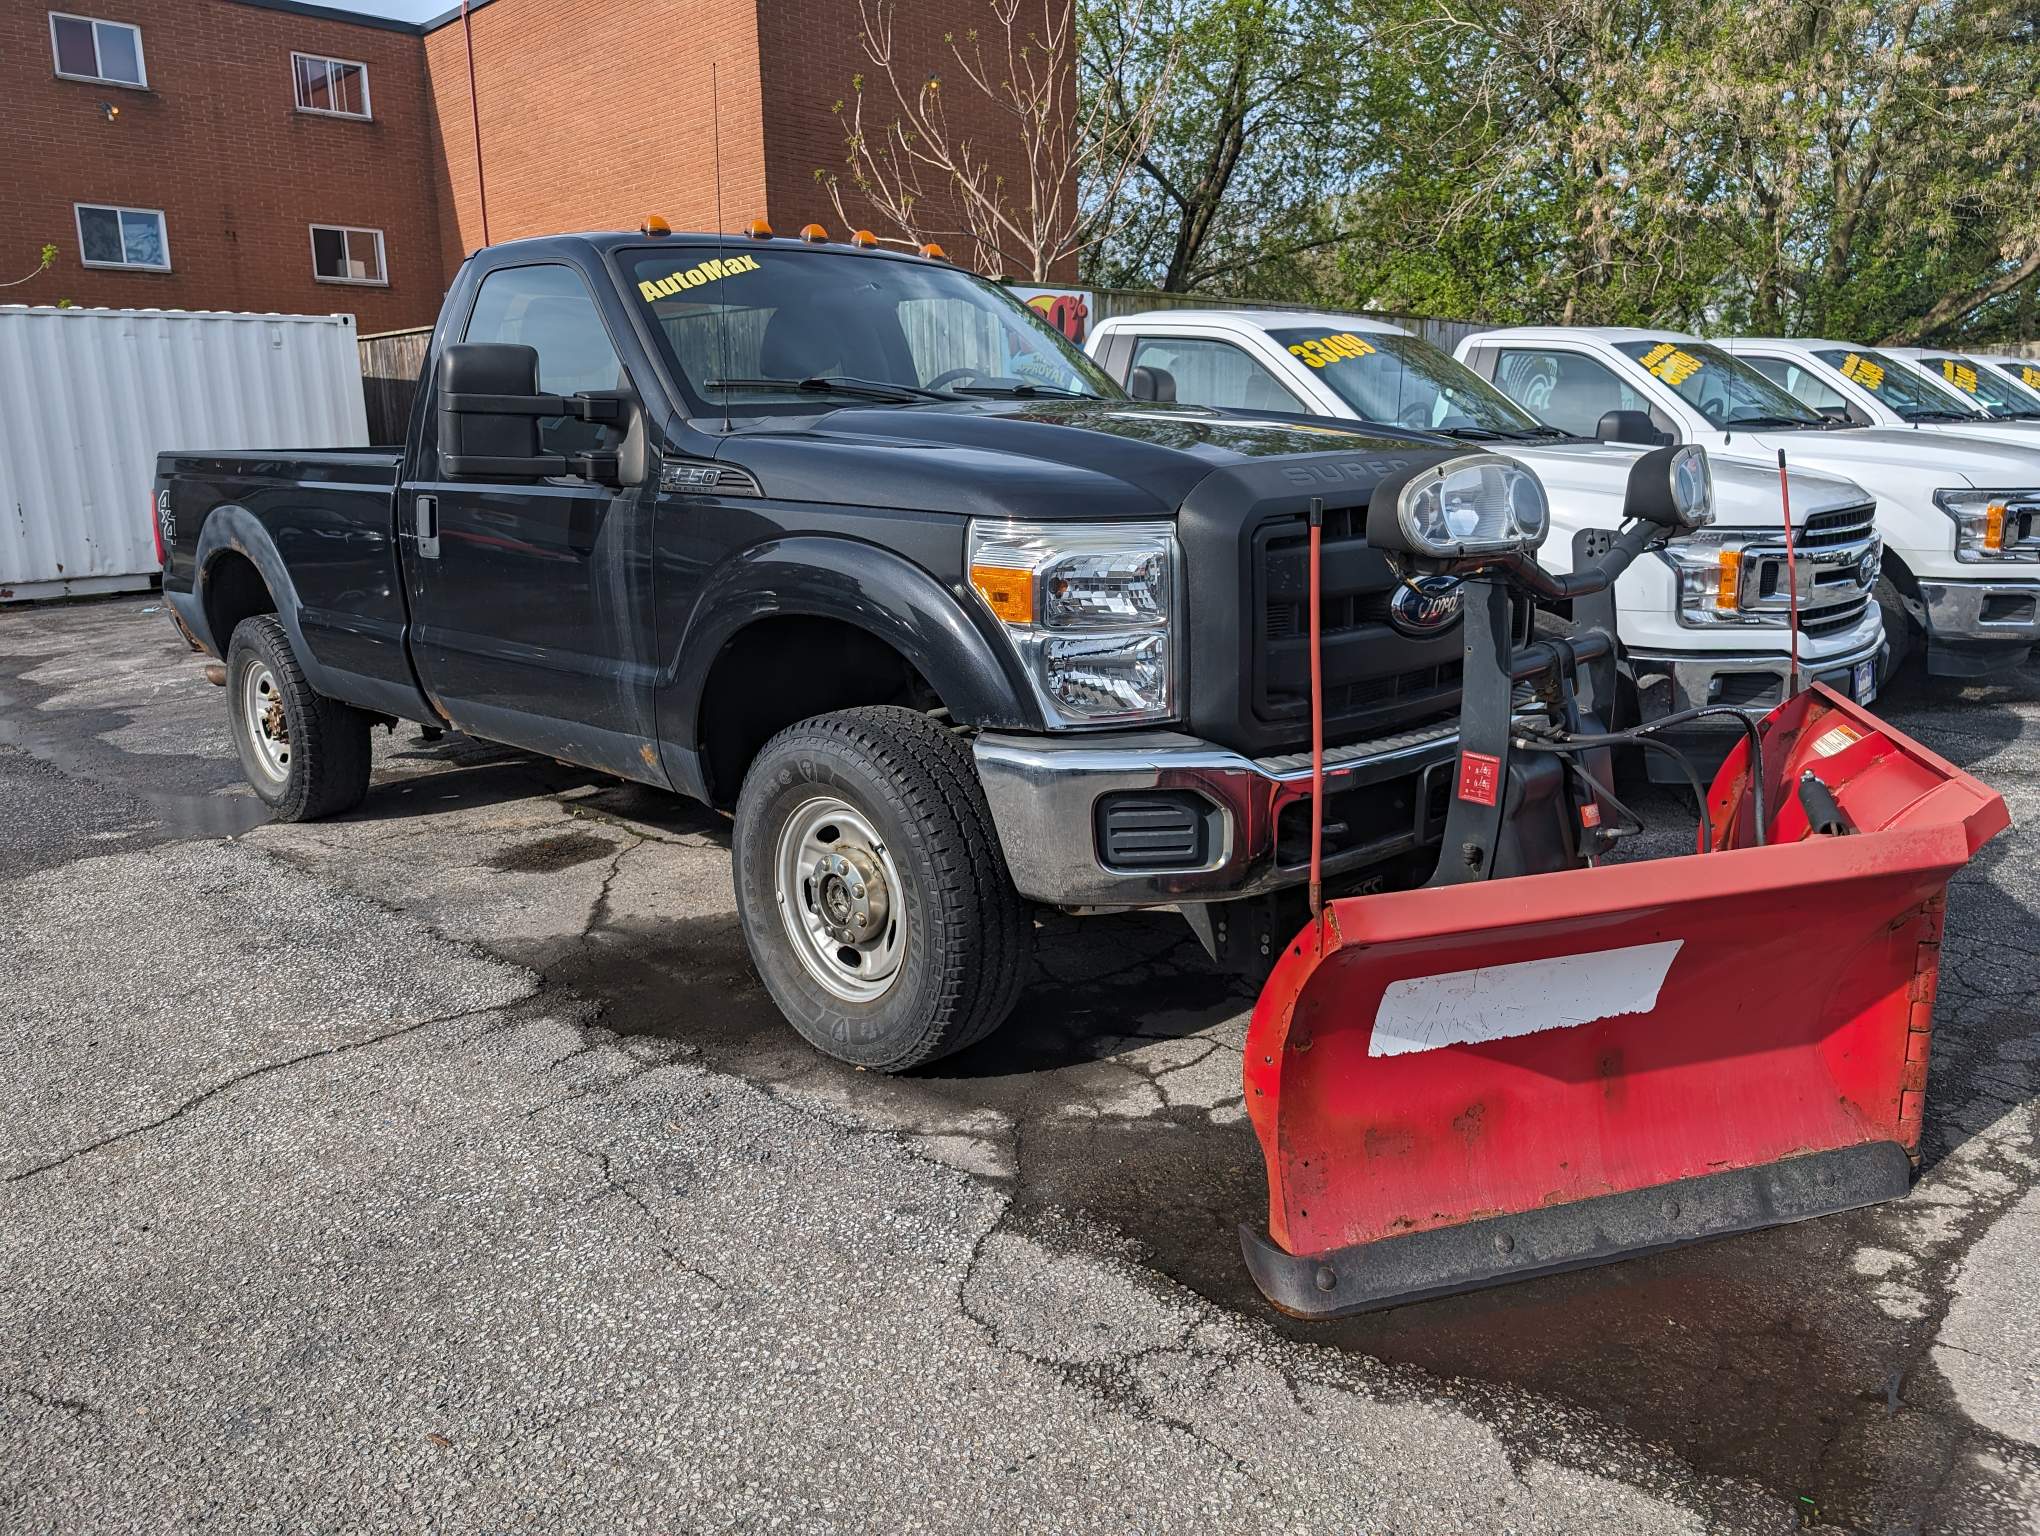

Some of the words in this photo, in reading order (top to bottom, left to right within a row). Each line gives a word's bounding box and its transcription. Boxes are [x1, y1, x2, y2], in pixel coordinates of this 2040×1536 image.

[638, 254, 761, 303] AutoMax
[1287, 333, 1377, 368] 33499
[1417, 583, 1465, 619] Ford
